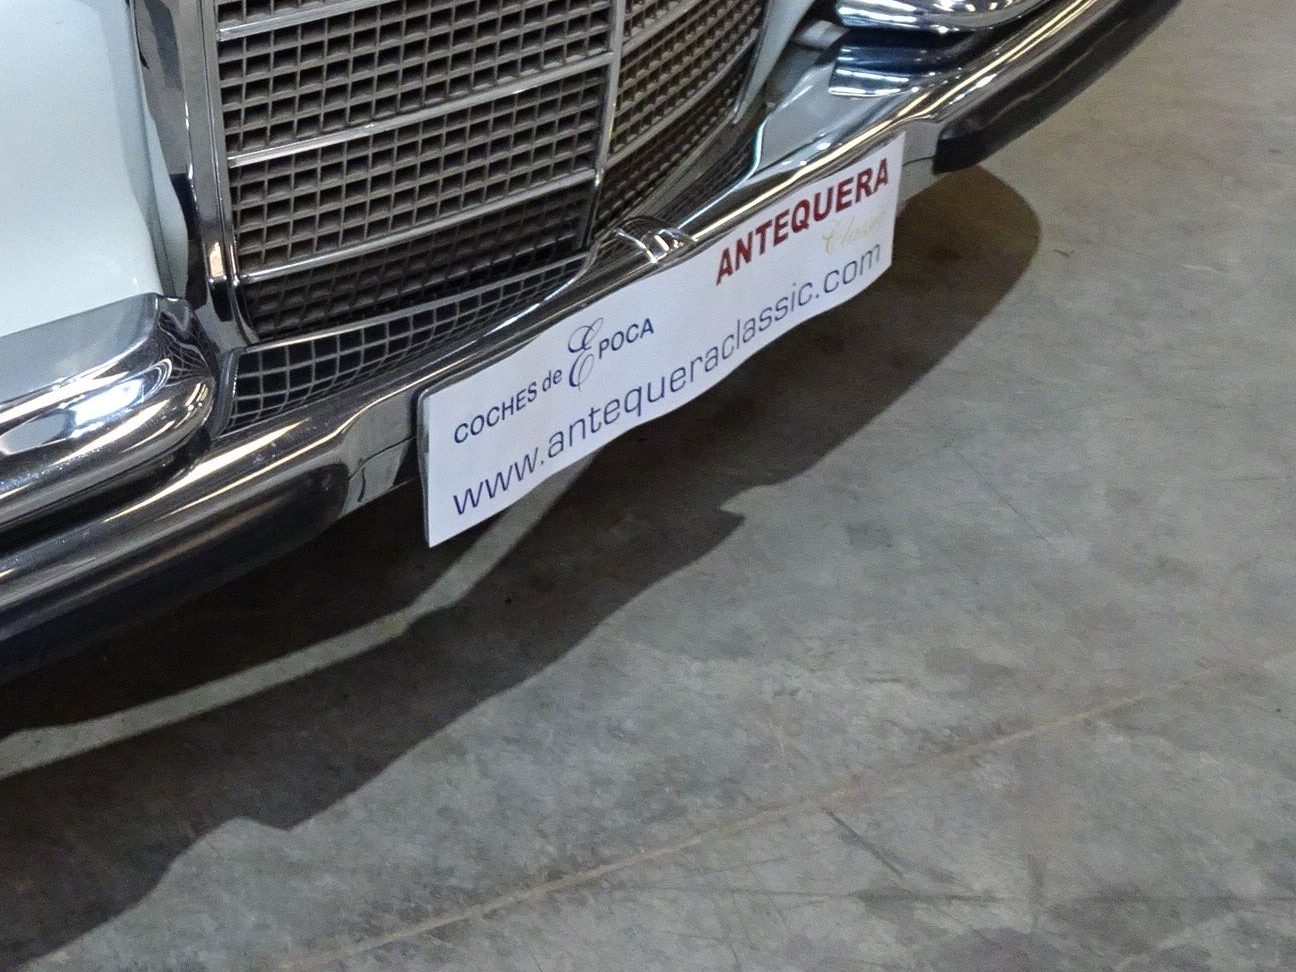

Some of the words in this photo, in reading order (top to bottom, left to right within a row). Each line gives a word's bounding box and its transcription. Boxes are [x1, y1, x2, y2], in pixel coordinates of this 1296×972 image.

[716, 157, 890, 286] ANTEQUERA
[453, 243, 881, 516] www.antequeraclassic.com
[454, 381, 538, 444] COCHES
[542, 368, 563, 392] de
